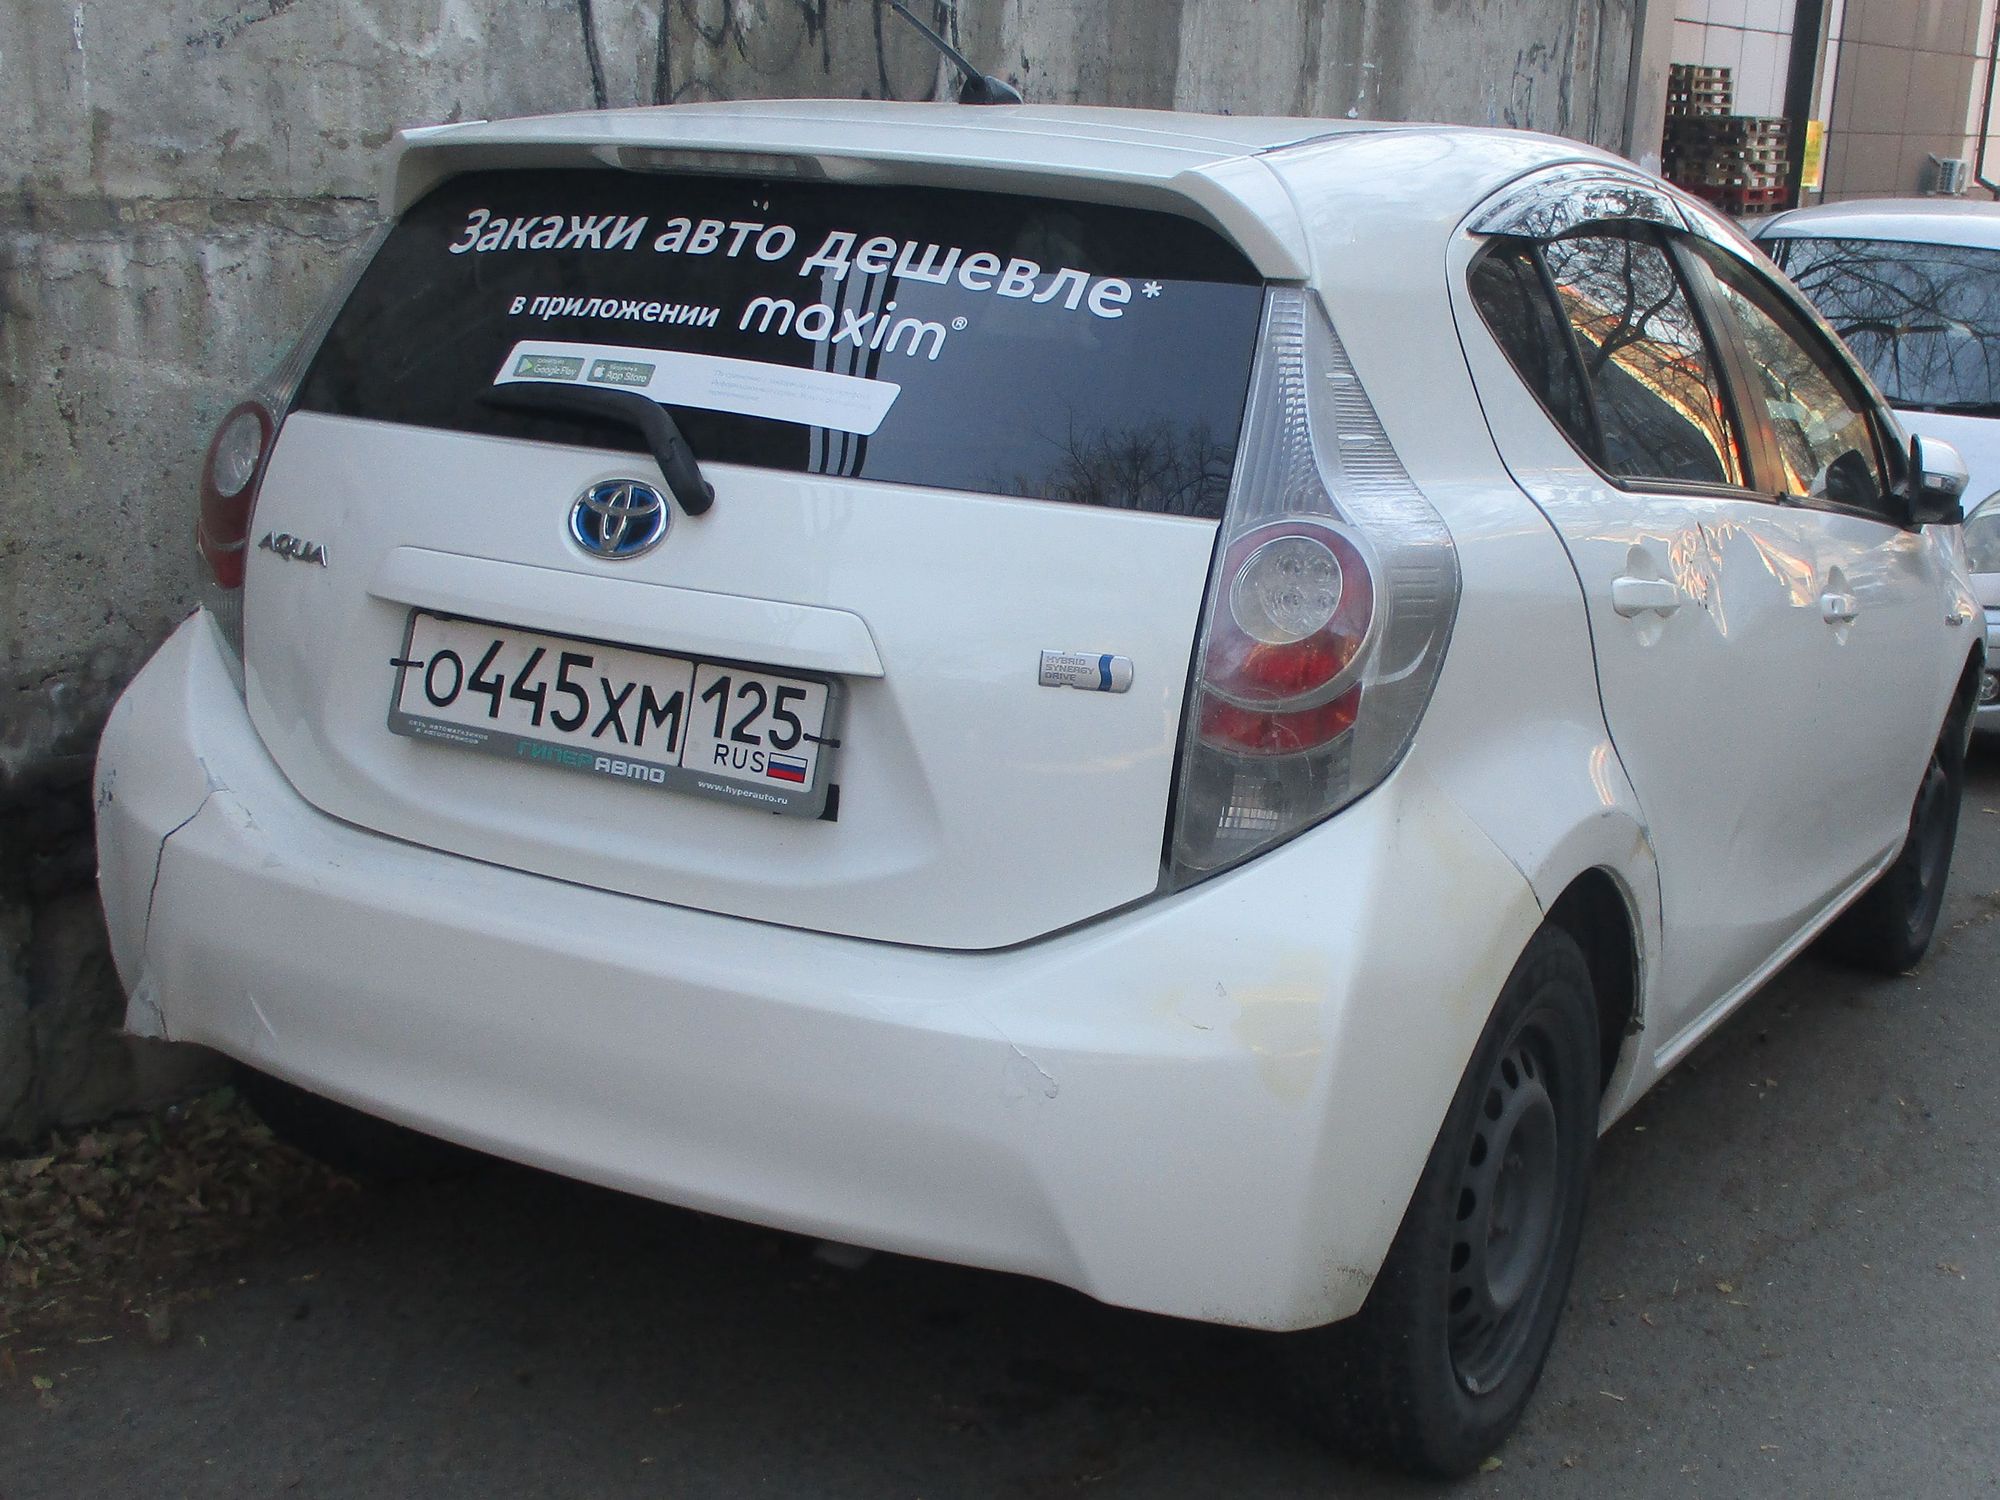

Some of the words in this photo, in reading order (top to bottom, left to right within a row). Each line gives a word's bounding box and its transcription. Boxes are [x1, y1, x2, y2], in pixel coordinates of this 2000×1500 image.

[450, 208, 648, 254] Закажи
[653, 216, 796, 261] авто
[508, 296, 527, 316] в
[533, 296, 720, 327] приложении
[533, 363, 560, 377] Google
[606, 370, 623, 382] App
[624, 371, 648, 383] Store
[258, 531, 328, 568] AQUA
[1045, 664, 1095, 675] SYNERGY
[1046, 655, 1086, 666] HYBRID
[1045, 672, 1077, 682] DRIVE
[701, 676, 807, 751] 125
[713, 743, 765, 773] RUS
[698, 780, 788, 805] www.hyperauto.ru
